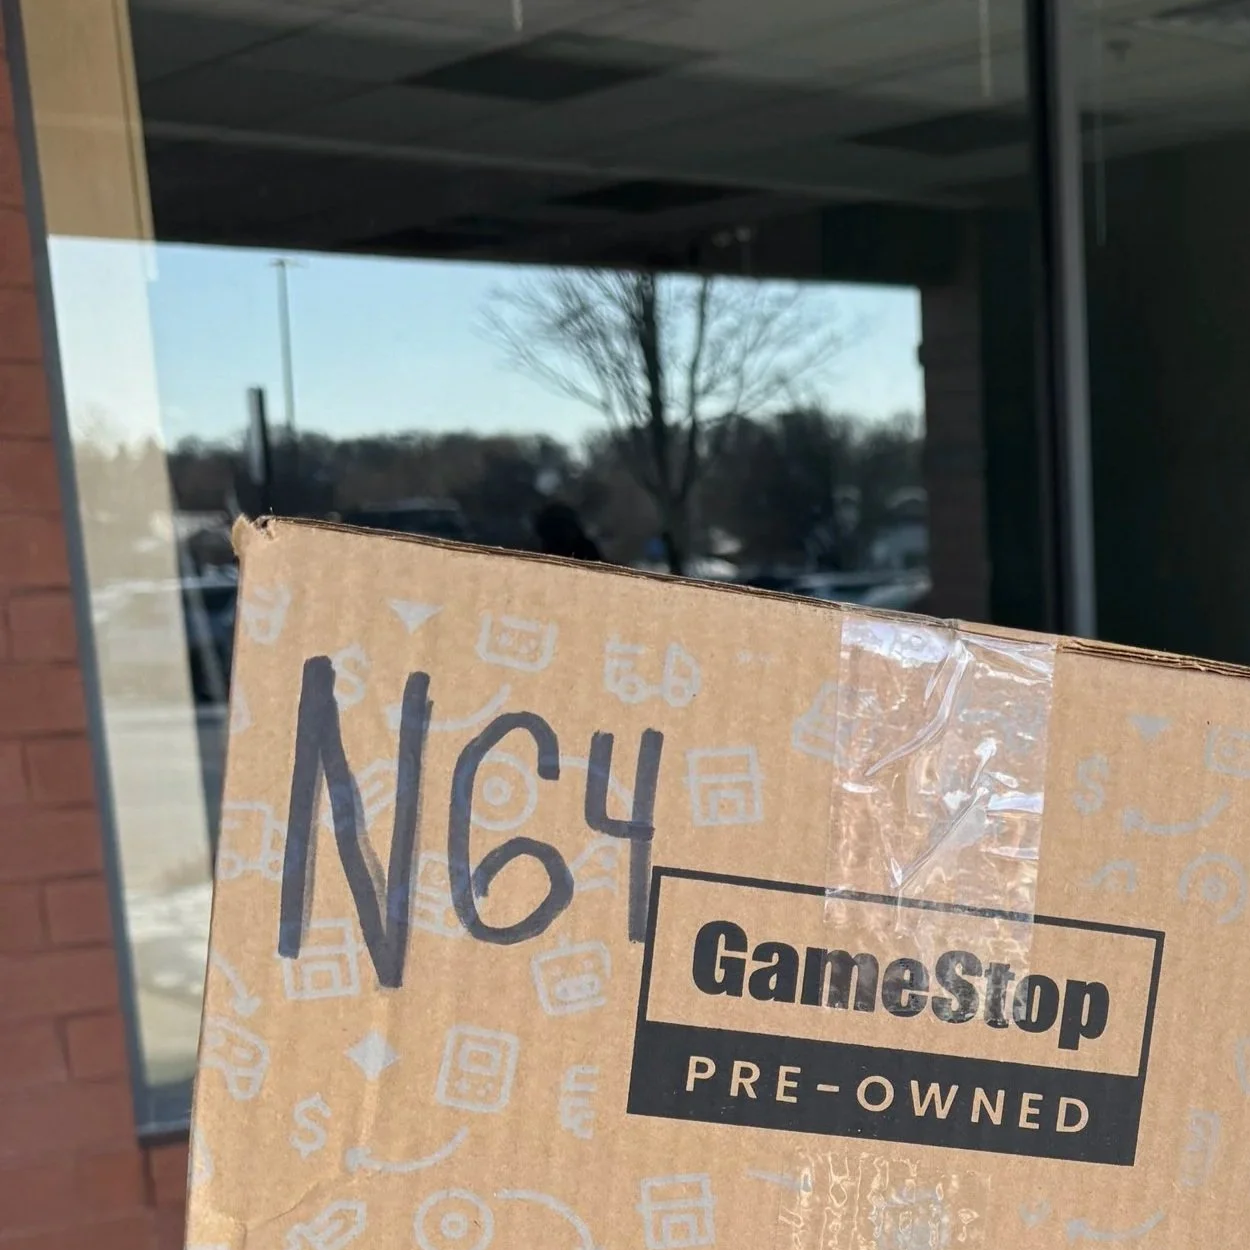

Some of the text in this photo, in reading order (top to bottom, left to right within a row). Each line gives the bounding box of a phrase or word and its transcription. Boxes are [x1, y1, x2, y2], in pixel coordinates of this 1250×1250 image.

[278, 655, 663, 988] N64
[692, 920, 1110, 1050] GameStop
[686, 1056, 1089, 1133] PRE-OWNED
